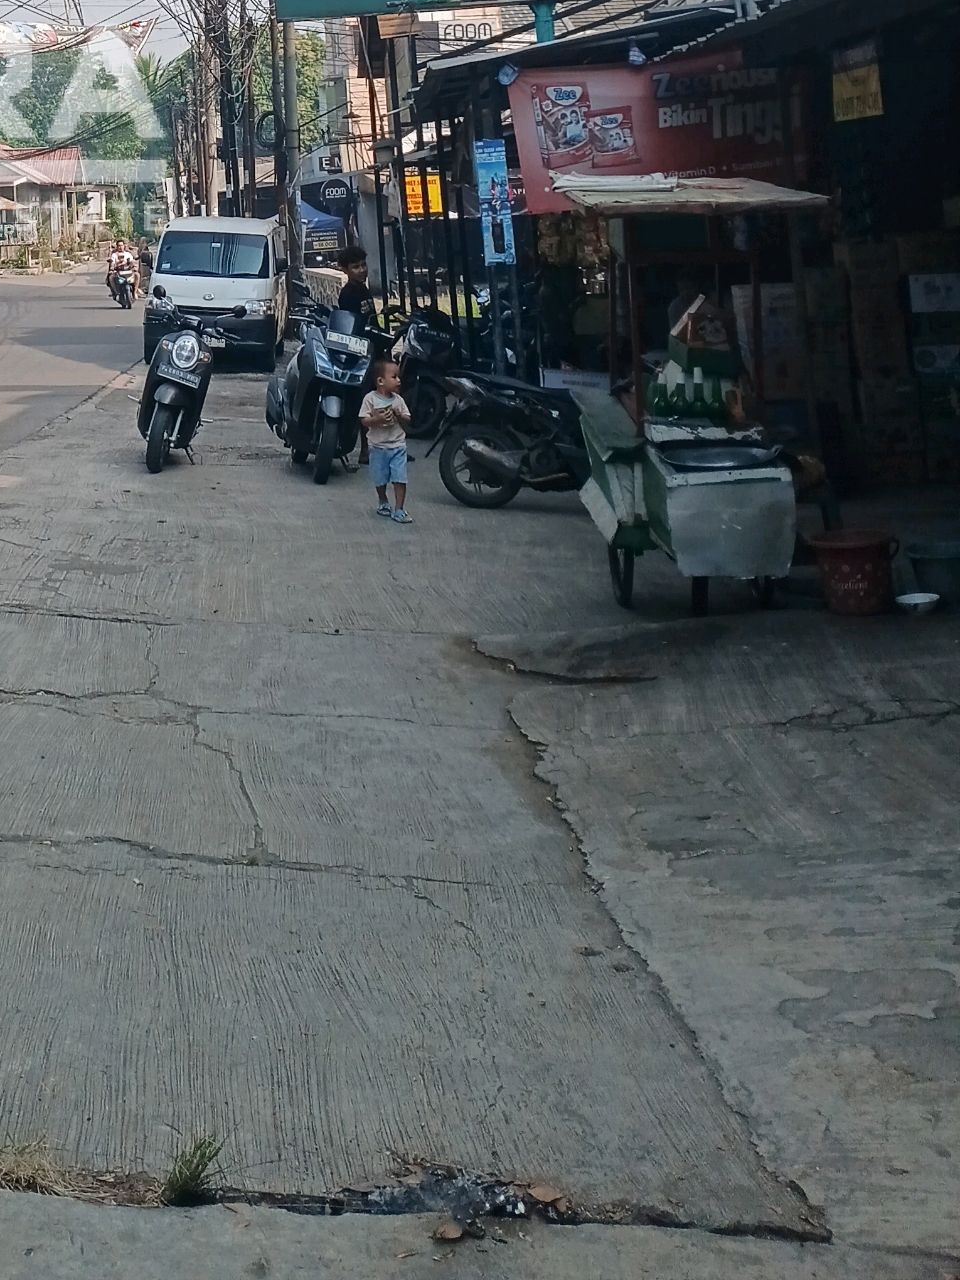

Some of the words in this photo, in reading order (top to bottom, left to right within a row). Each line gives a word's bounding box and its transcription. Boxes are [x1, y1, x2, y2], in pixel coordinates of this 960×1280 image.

[443, 22, 493, 40] FOOM
[553, 87, 578, 101] Zee
[658, 102, 708, 129] Bikin
[663, 167, 708, 179] Vitamin
[325, 187, 347, 197] FOOM
